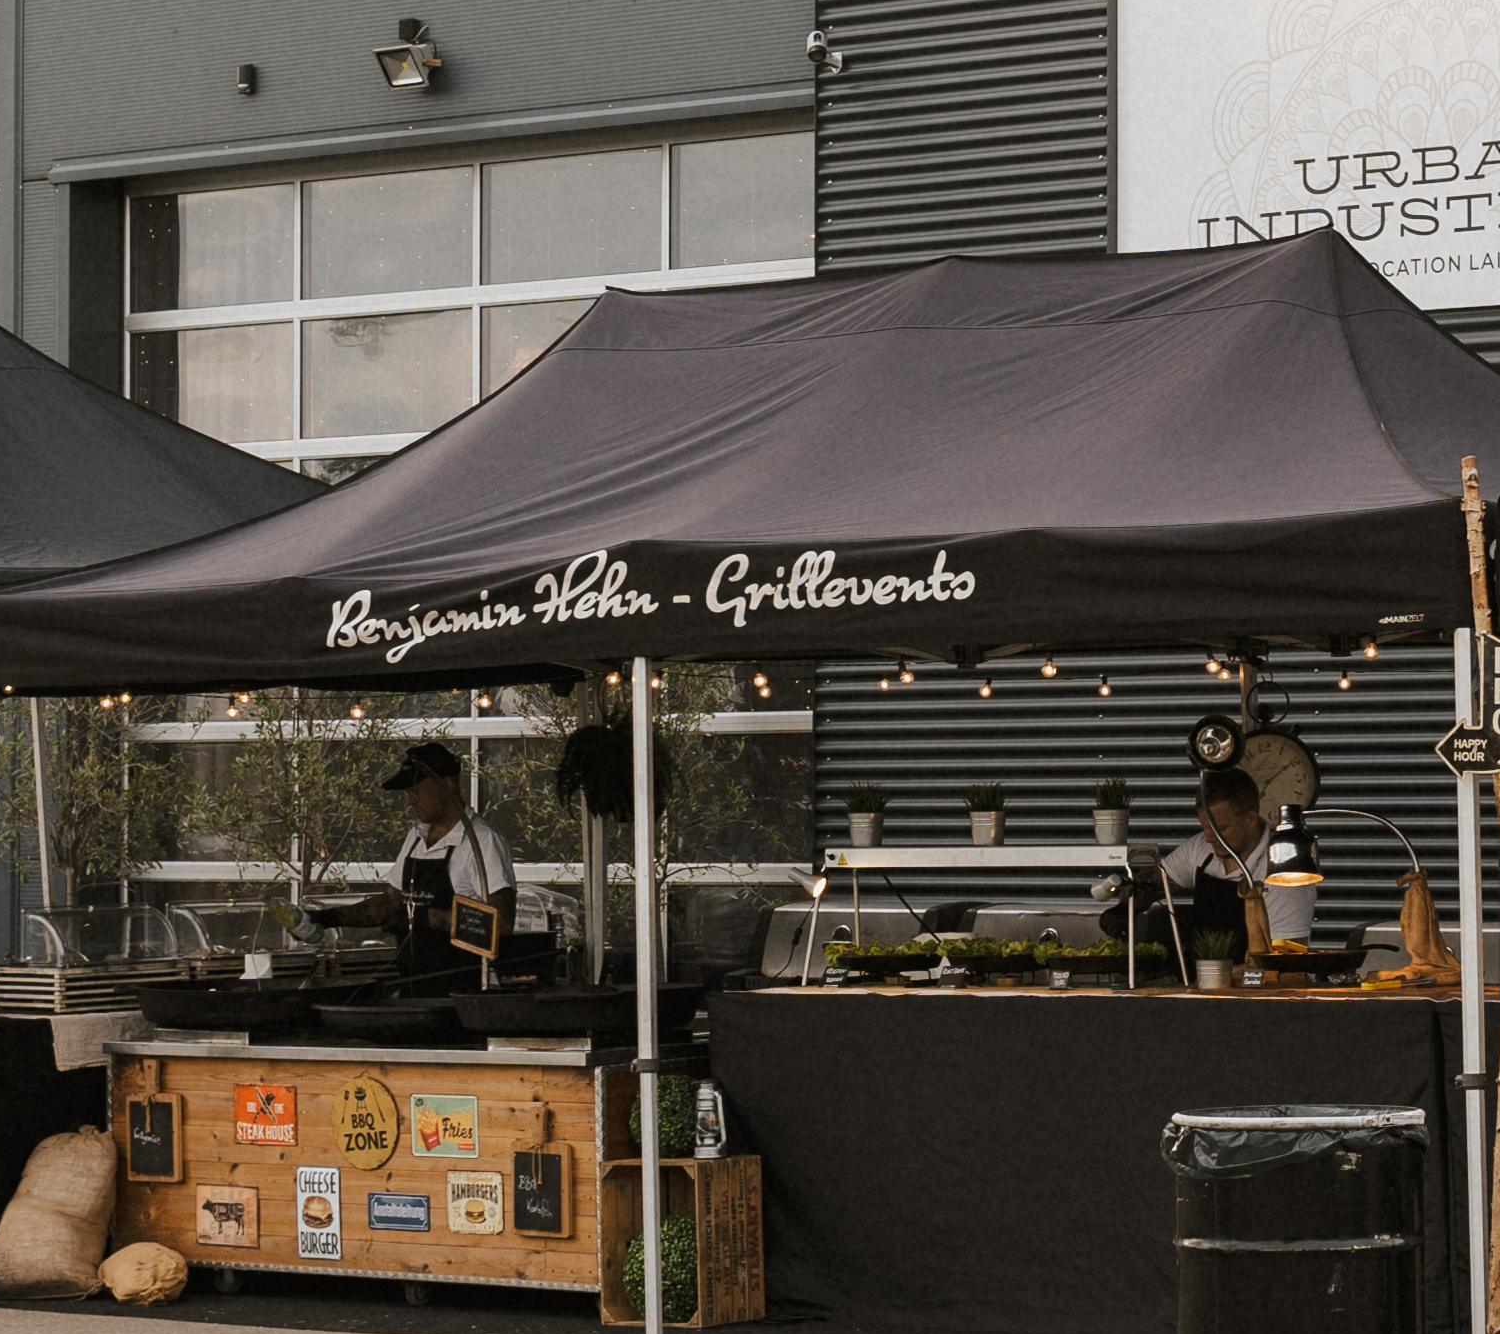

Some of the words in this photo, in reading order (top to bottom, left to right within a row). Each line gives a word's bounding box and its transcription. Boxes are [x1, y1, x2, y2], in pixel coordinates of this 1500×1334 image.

[325, 589, 527, 663] Benjamin
[532, 550, 659, 624] Hehn
[706, 550, 976, 627] Grillevents
[1454, 738, 1488, 750] HAPPY
[1454, 751, 1485, 762] HOUR
[236, 1122, 264, 1140] STEAK
[265, 1124, 295, 1143] HOUSE
[351, 1113, 375, 1130] BBQ
[442, 1117, 473, 1140] Fries
[344, 1131, 388, 1152] ZONE
[300, 1171, 336, 1194] CHEESE
[451, 1183, 499, 1204] HAMBURGERS
[704, 1172, 712, 1216] WHISKY
[300, 1232, 339, 1255] BURGER
[705, 1220, 713, 1263] SCOTCH
[747, 1184, 760, 1292] STEWART'S
[706, 1266, 714, 1319] BLENDED
